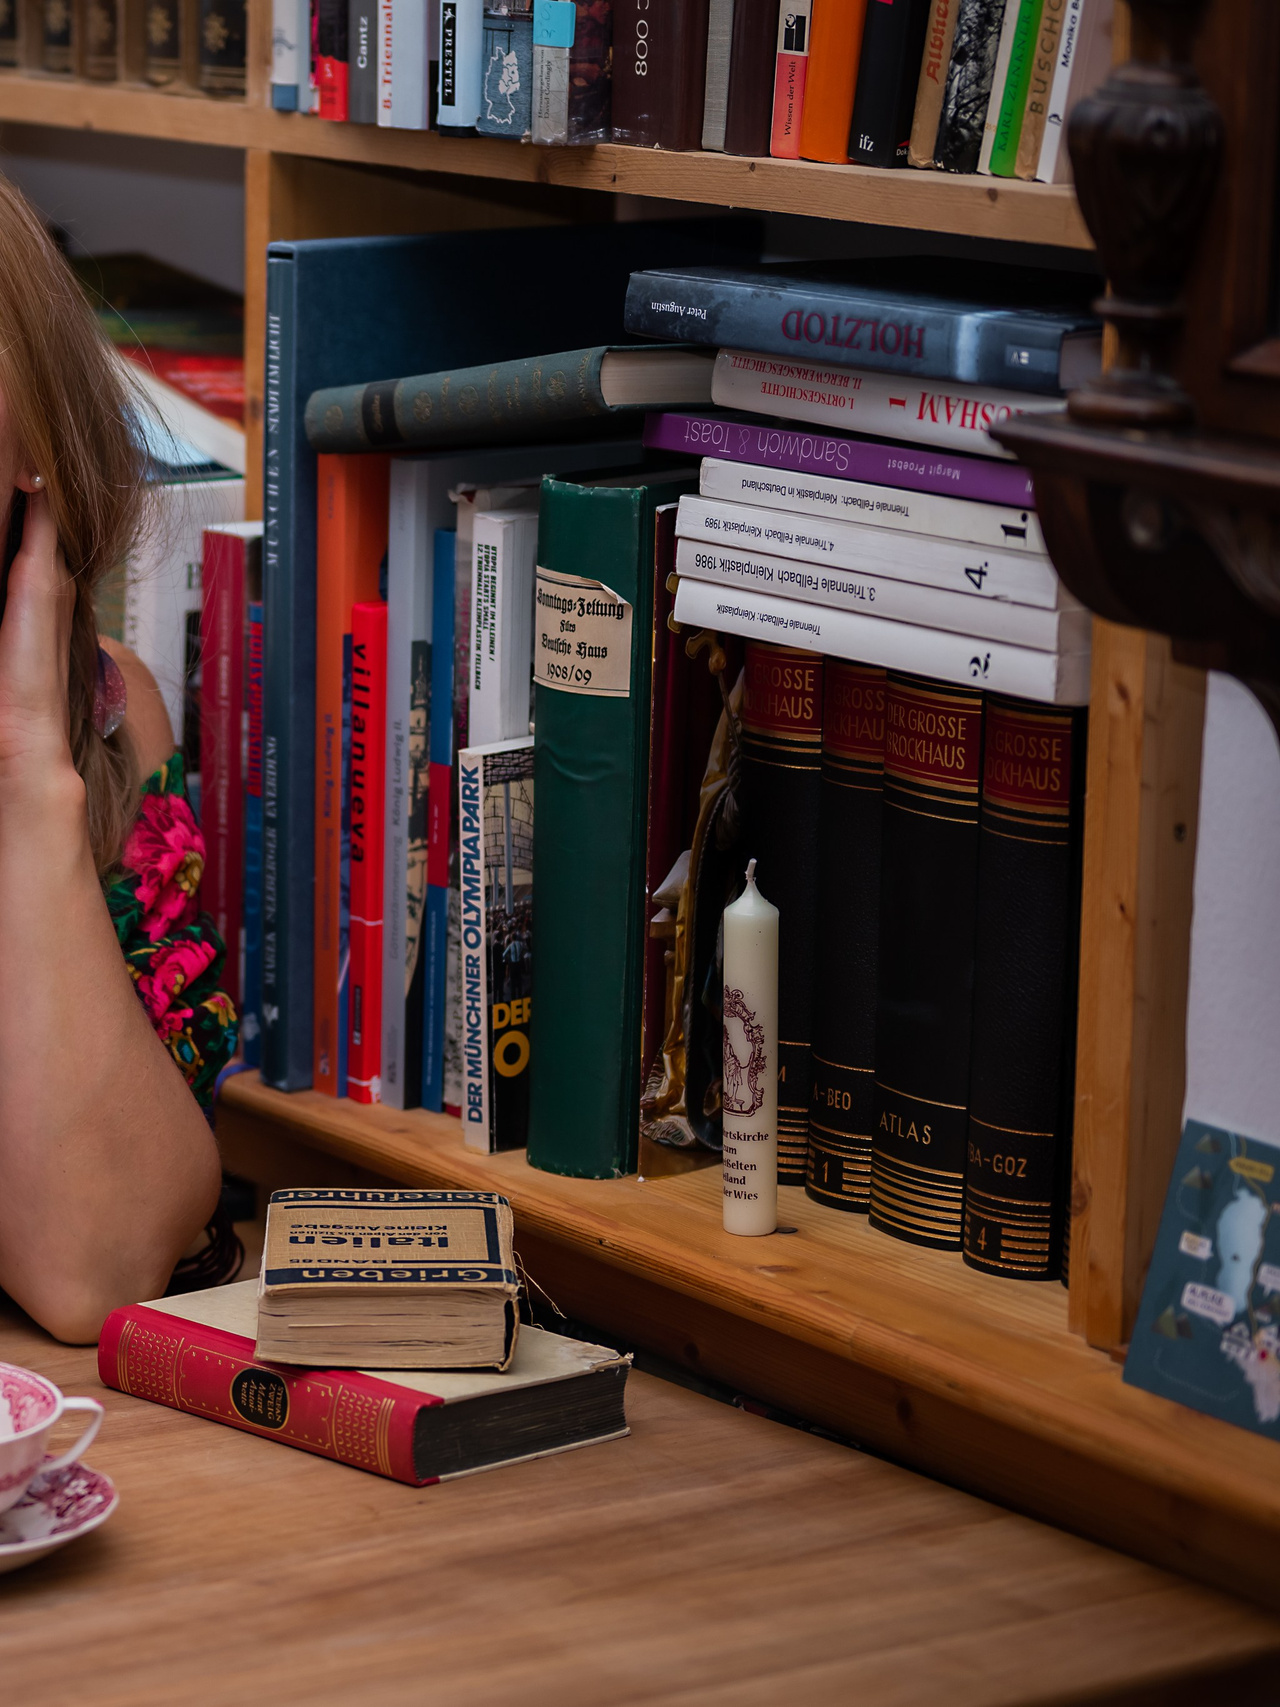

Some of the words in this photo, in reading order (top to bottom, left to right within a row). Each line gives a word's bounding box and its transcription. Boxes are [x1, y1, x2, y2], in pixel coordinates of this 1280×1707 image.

[356, 16, 369, 69] Cantz
[634, 20, 649, 76] 800
[1061, 15, 1078, 68] Monika
[444, 28, 454, 97] PRESTEL
[787, 61, 797, 84] Welt
[544, 60, 553, 96] Cordingly
[998, 107, 1014, 152] KARL
[1007, 14, 1031, 101] ZENKNER
[381, 92, 393, 110] 8.
[786, 85, 796, 101] der
[784, 103, 795, 136] Wissen
[858, 134, 874, 152] ifz
[650, 301, 686, 318] Augustin
[685, 306, 708, 320] Peter
[781, 310, 925, 359] HOLZTOD
[730, 355, 850, 388] BERGWERKSGESCHICHTE
[851, 376, 862, 390] II.
[760, 381, 846, 407] ORTSGESCHICHTE
[917, 392, 1024, 434] USHAM
[683, 420, 731, 454] Toast
[737, 427, 752, 454] &
[757, 430, 851, 472] Sandwich
[887, 458, 926, 475] Proebst
[929, 463, 961, 481] Margit
[741, 478, 786, 496] Deutschland
[787, 487, 795, 497] in
[795, 486, 838, 506] Kleinplastik
[840, 493, 874, 511] Fellbach:
[876, 499, 910, 517] Triennale
[704, 517, 721, 530] 1989
[722, 519, 762, 538] Kleinplastik
[764, 528, 793, 544] Fellbach
[1000, 512, 1028, 547] 1.
[694, 552, 718, 571] 1986
[719, 557, 775, 581] Kleinplastik
[777, 569, 820, 590] Fellbach
[964, 561, 989, 590] 4.
[475, 598, 483, 651] KLEINPLASTIK
[490, 610, 496, 620] IM
[716, 603, 756, 622] Kleinplastik
[756, 611, 789, 630] Fellbach:
[788, 618, 822, 636] Triennale
[576, 642, 608, 660] Haus
[546, 662, 592, 686] 1908/09
[754, 664, 815, 692] GROSSE
[744, 689, 815, 721] OCKHAUS
[834, 684, 885, 712] GROSS
[826, 710, 885, 742] OCKHAU
[887, 702, 906, 727] DER
[907, 709, 967, 741] GROSSE
[352, 644, 370, 863] villanueva
[392, 734, 404, 784] Ludwig
[886, 732, 966, 770] BROCKHAUS
[995, 730, 1062, 762] GROSSE
[986, 757, 1062, 792] OCKHAUS
[391, 787, 403, 827] König
[461, 764, 482, 950] OLYMPIAPARK
[464, 954, 483, 1088] MÜNCHNER
[467, 1092, 483, 1124] DER
[879, 1112, 932, 1145] ATLAS
[822, 1160, 828, 1183] 1
[969, 1141, 1027, 1178] BA-GOZ
[278, 1191, 498, 1204] Reiseführer
[733, 1189, 758, 1200] Wies
[290, 1223, 380, 1231] Ausgabe
[977, 1226, 987, 1250] 4
[289, 1236, 448, 1248] Italien
[302, 1269, 488, 1283] Grieben
[267, 1383, 277, 1420] ZWEIG
[275, 1386, 284, 1422] STEFAN
